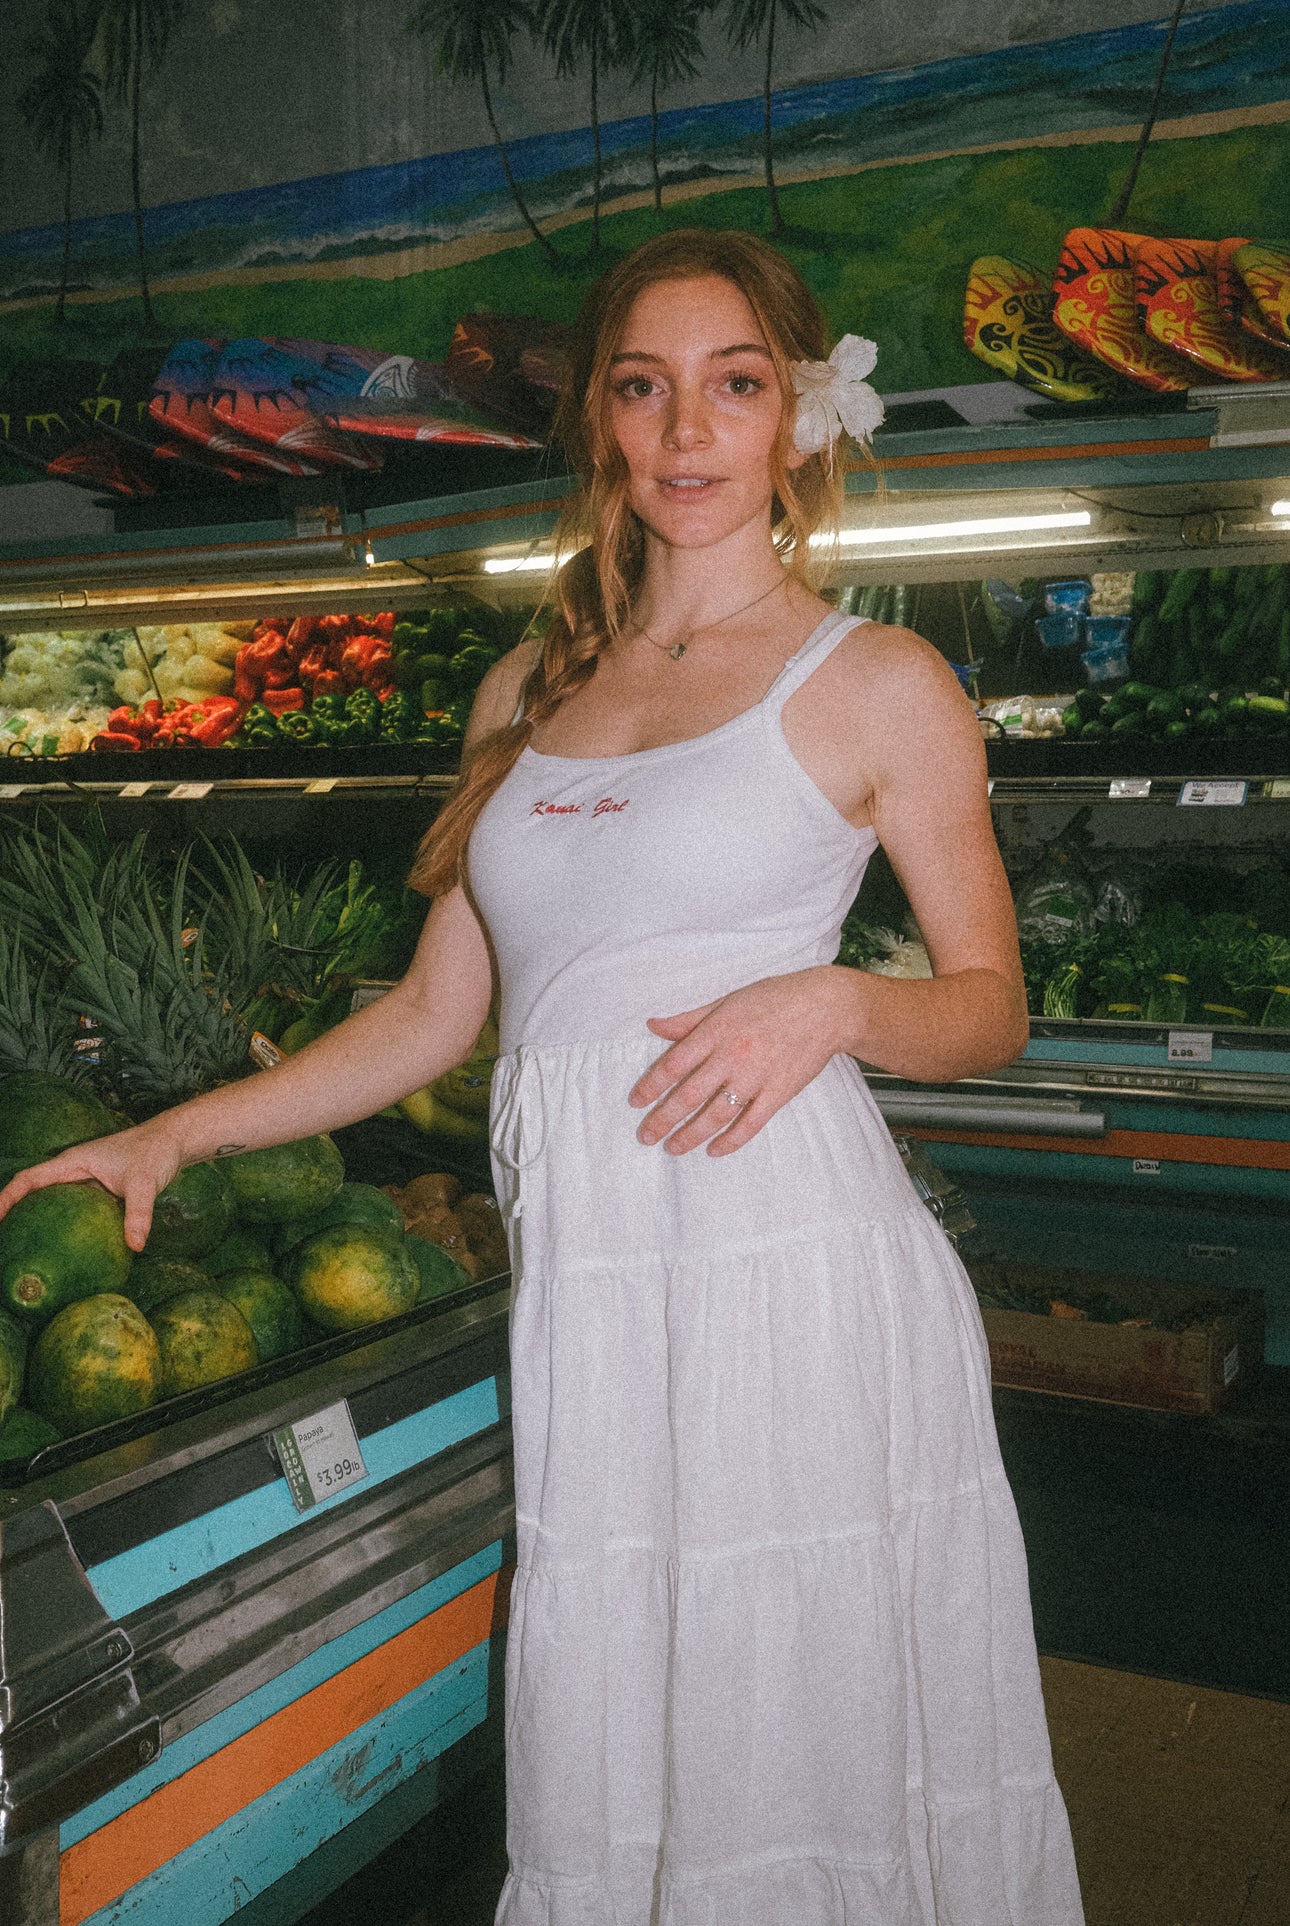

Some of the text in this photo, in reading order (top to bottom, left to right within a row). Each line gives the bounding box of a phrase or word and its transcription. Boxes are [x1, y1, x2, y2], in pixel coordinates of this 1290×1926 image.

[529, 797, 629, 818] Kauai Girl
[298, 1426, 324, 1442] Papaya
